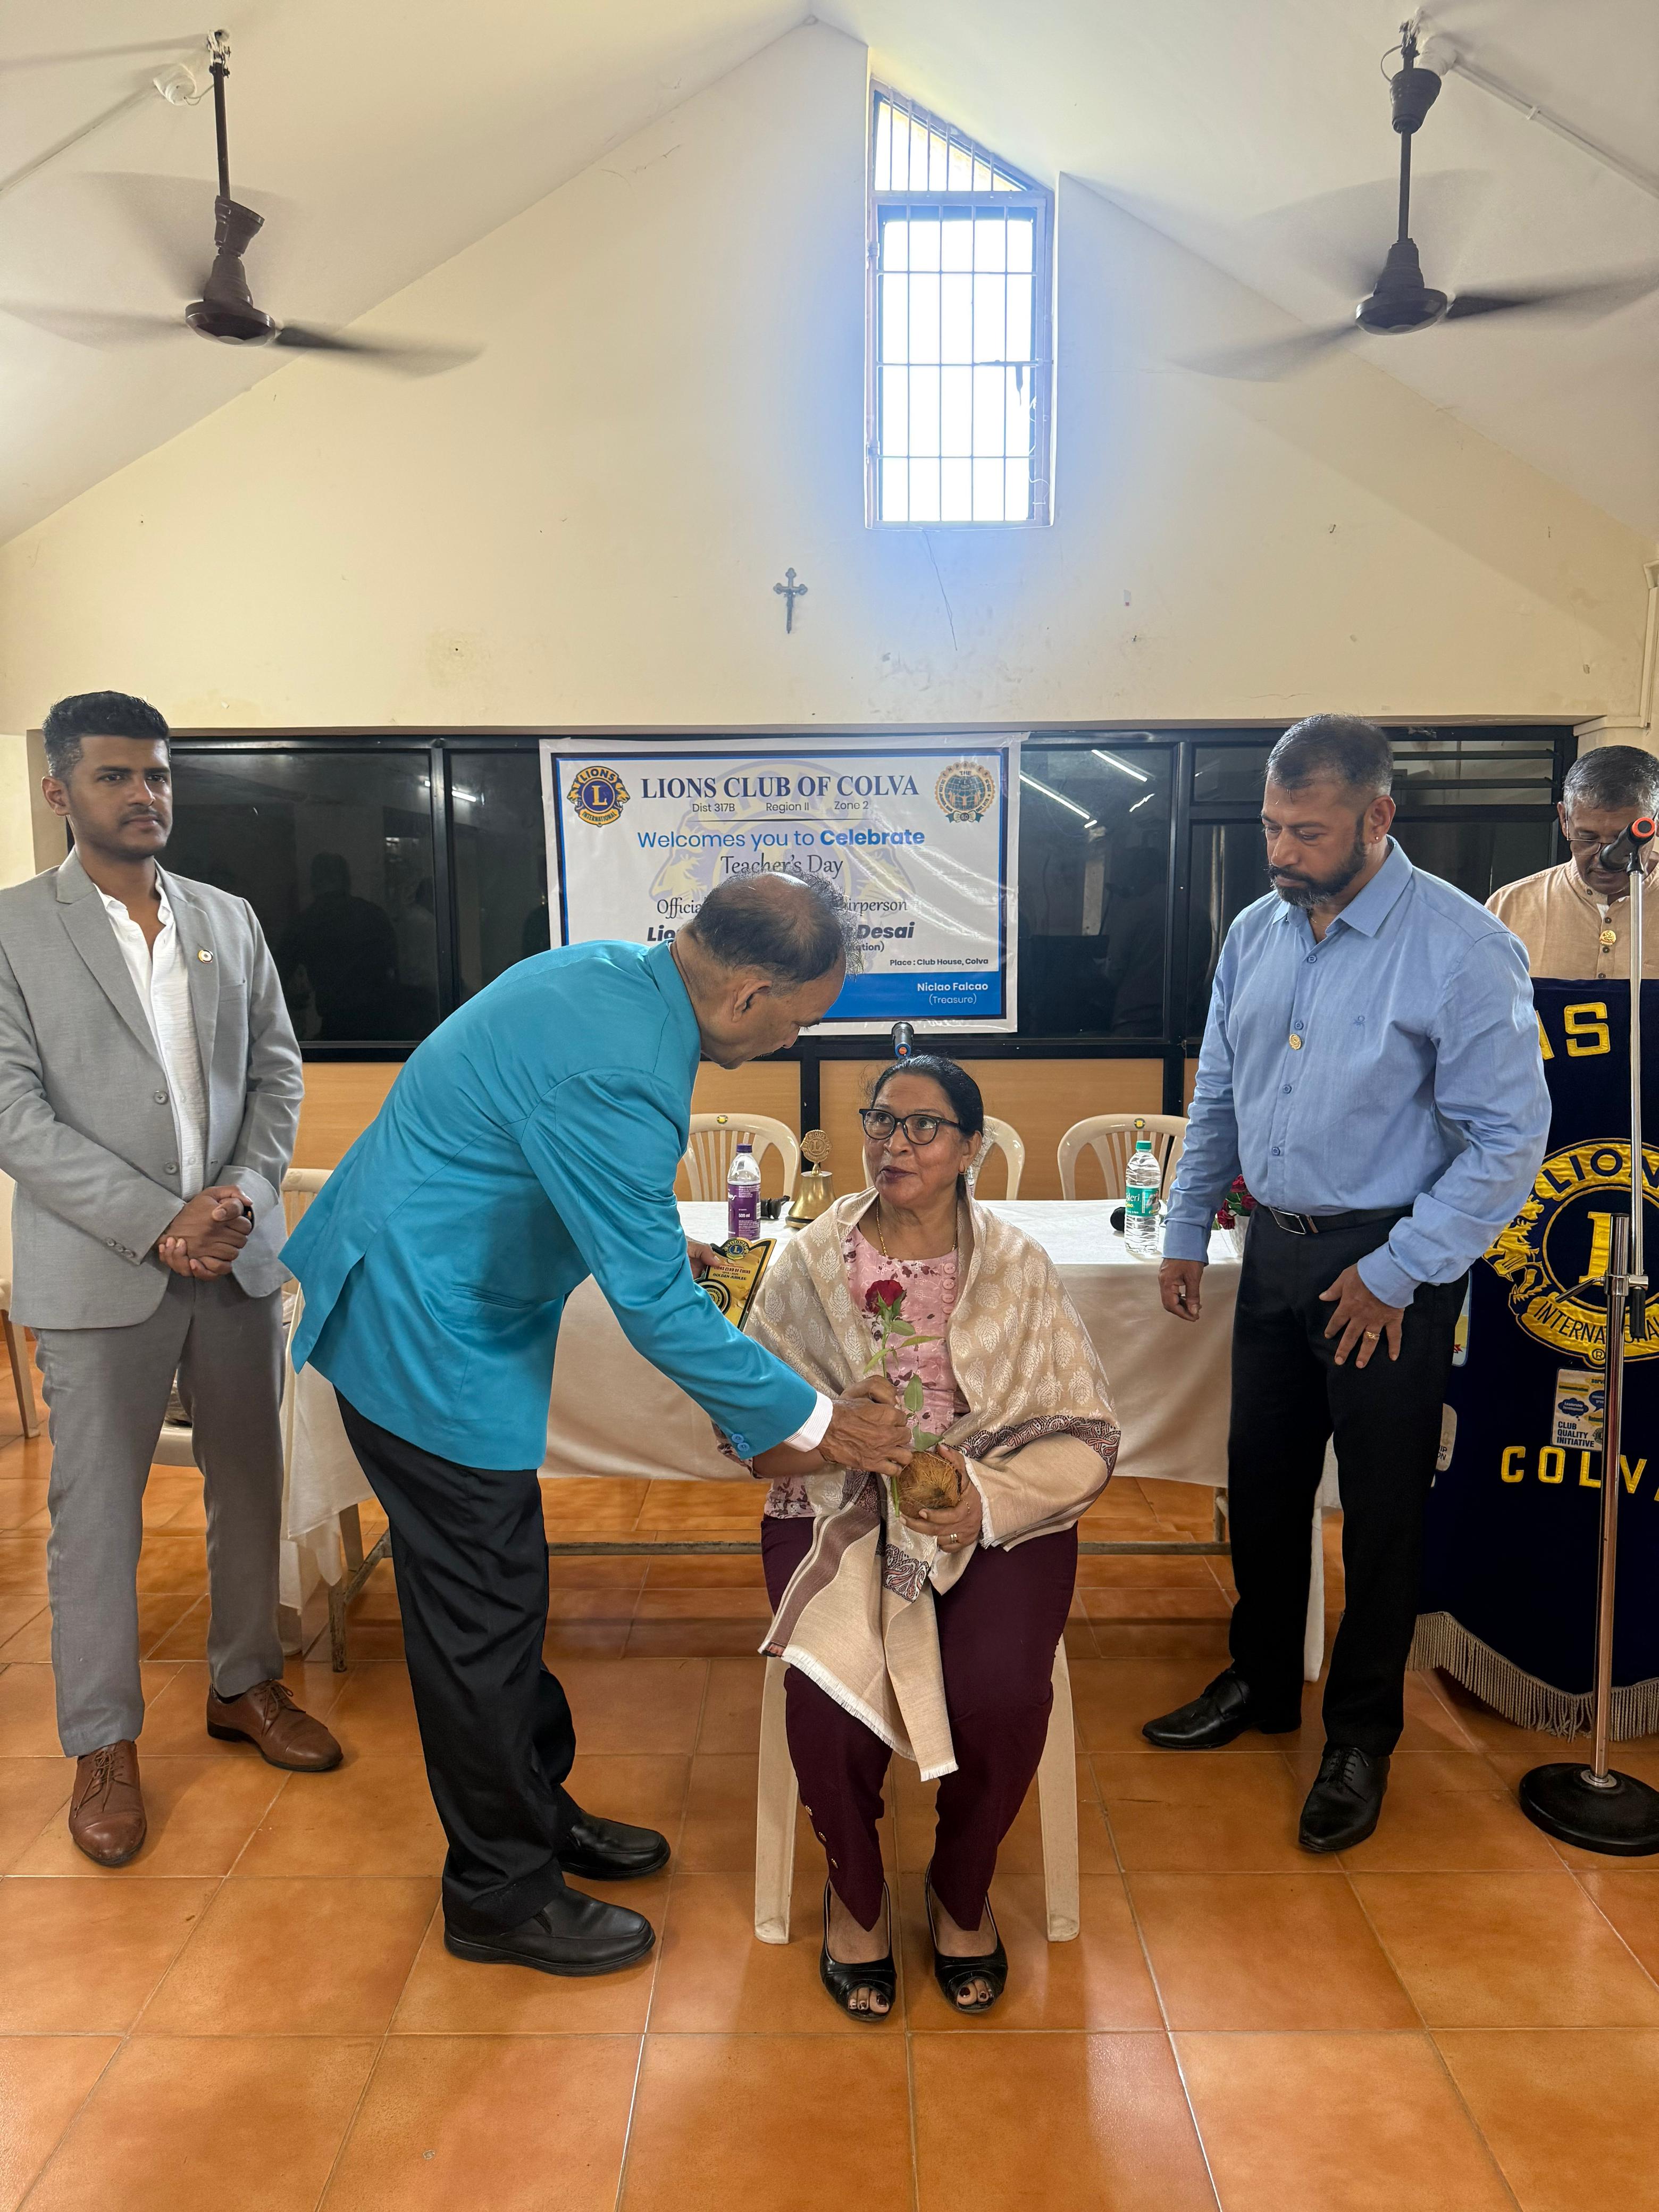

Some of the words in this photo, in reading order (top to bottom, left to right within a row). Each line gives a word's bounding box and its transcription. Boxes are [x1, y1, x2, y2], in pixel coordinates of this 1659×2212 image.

[580, 768, 615, 781] LIONS
[640, 777, 716, 798] LIONS
[723, 777, 791, 798] CLUB
[798, 776, 831, 797] OF
[837, 775, 919, 796] COLVA
[591, 785, 608, 806] L
[692, 803, 711, 812] Dist
[714, 803, 735, 811] 317B
[766, 802, 801, 814] Region
[805, 802, 809, 811] II
[862, 801, 869, 809] 2
[582, 811, 617, 822] INTERNATIONAL
[637, 831, 745, 848] Welcomes
[750, 834, 789, 851] you
[794, 831, 815, 846] to
[820, 828, 925, 845] Celebrate
[807, 854, 843, 879] Day
[657, 897, 701, 919] Officia
[647, 925, 676, 941] Lio
[857, 921, 915, 939] Desai
[917, 983, 951, 992] Niclao
[953, 982, 988, 991] Falcao
[929, 993, 977, 1005] (Treasure)
[1558, 1421, 1577, 1430] CLUB
[1557, 1429, 1588, 1439] QUALITY
[1557, 1436, 1595, 1447] INITIATIVE
[1501, 1446, 1659, 1502] COLV
